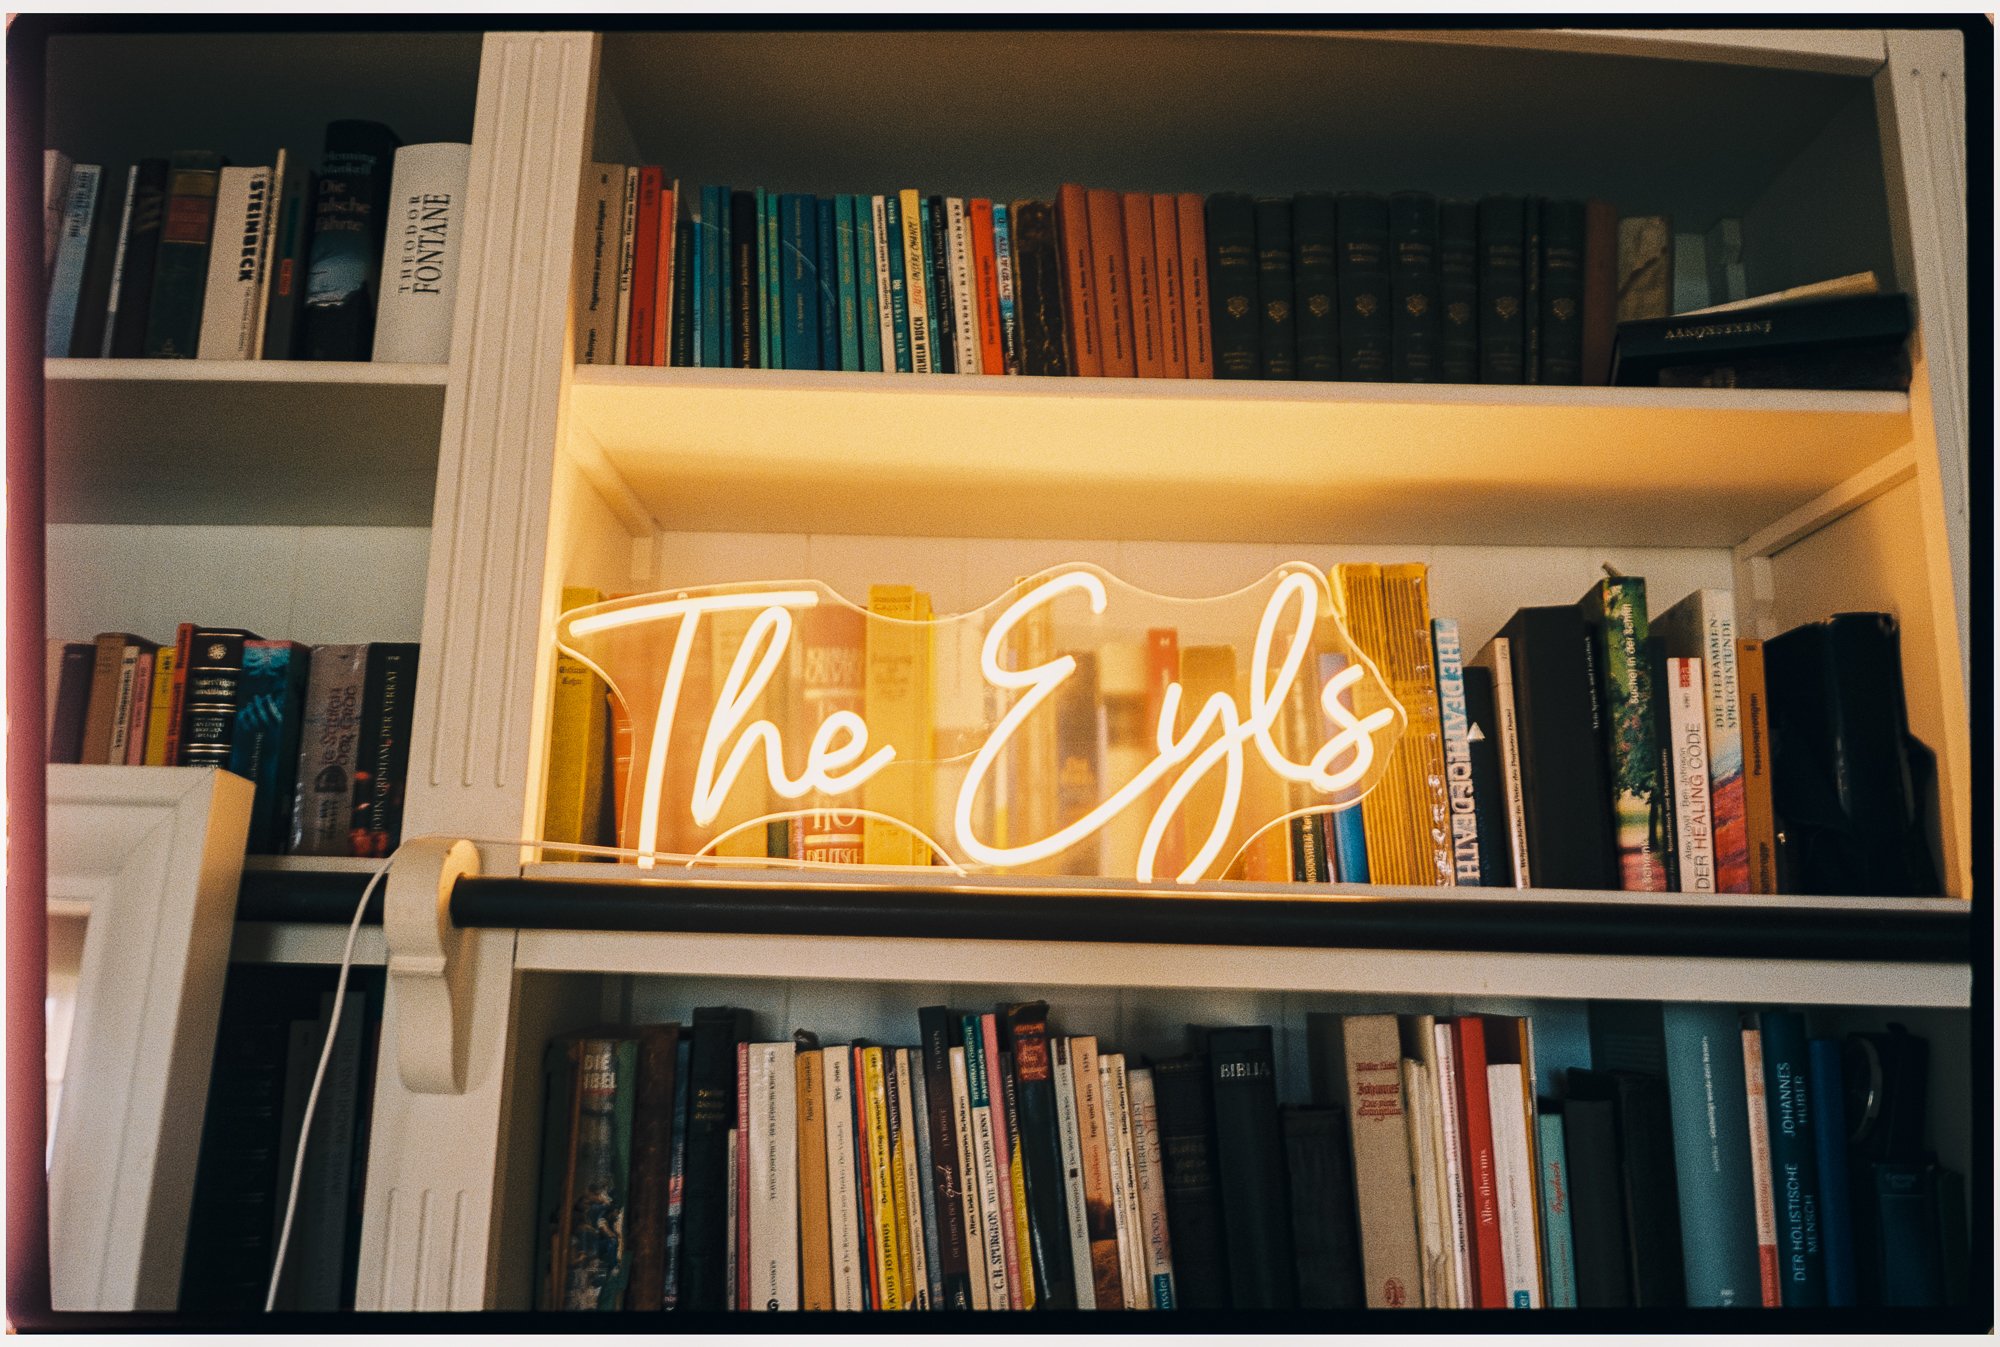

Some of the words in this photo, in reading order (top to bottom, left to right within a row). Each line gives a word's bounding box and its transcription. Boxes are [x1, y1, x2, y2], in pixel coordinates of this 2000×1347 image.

[239, 179, 264, 282] STEINBECK
[398, 196, 420, 295] THEODOR
[412, 193, 451, 295] FONTANE
[954, 202, 965, 260] BEGONNEN
[1002, 268, 1013, 300] GRACE
[914, 315, 924, 340] BUSCH
[962, 292, 972, 339] ZUKUNFT
[1619, 602, 1635, 634] Schrift
[1437, 626, 1462, 676] THE
[1623, 635, 1635, 655] der
[1709, 611, 1722, 701] HEBAMMEN-
[384, 670, 397, 712] VERRAT
[1626, 669, 1641, 705] Suchet
[1722, 618, 1737, 728] SPRECHSTUNDE
[382, 716, 392, 737] DER
[569, 588, 897, 870] The
[955, 560, 1397, 886] Eyls
[1441, 677, 1470, 760] DEATH
[1713, 705, 1724, 728] DIE
[1687, 722, 1703, 769] CODE
[376, 741, 391, 797] GRISHAM
[1447, 762, 1473, 795] OF
[369, 800, 385, 831] JOHN
[1690, 774, 1708, 849] HEALING
[1451, 796, 1481, 880] DEATH
[1695, 854, 1711, 890] DER
[584, 1053, 611, 1071] DIE
[1219, 1061, 1271, 1078] BIBLIA
[1776, 1061, 1796, 1137] JOHANNES
[1794, 1075, 1808, 1124] HUBER
[979, 1111, 988, 1138] KENNT
[1089, 1119, 1099, 1137] Inge
[982, 1139, 992, 1167] KEINER
[1133, 1118, 1149, 1172] HERRLICH
[1477, 1147, 1489, 1170] uns
[988, 1187, 996, 1203] WIE
[1478, 1172, 1492, 1196] über
[1481, 1198, 1494, 1225] Alles
[1784, 1162, 1804, 1251] HOLISTISCHE
[1803, 1194, 1819, 1254] MENSCH
[987, 1209, 1004, 1265] SPURGEON
[1146, 1211, 1164, 1244] BOOM
[883, 1222, 894, 1272] JOSEPHUS
[1152, 1246, 1164, 1266] TEN
[994, 1266, 1004, 1278] H.
[996, 1279, 1005, 1289] C.
[1792, 1254, 1808, 1282] DER
